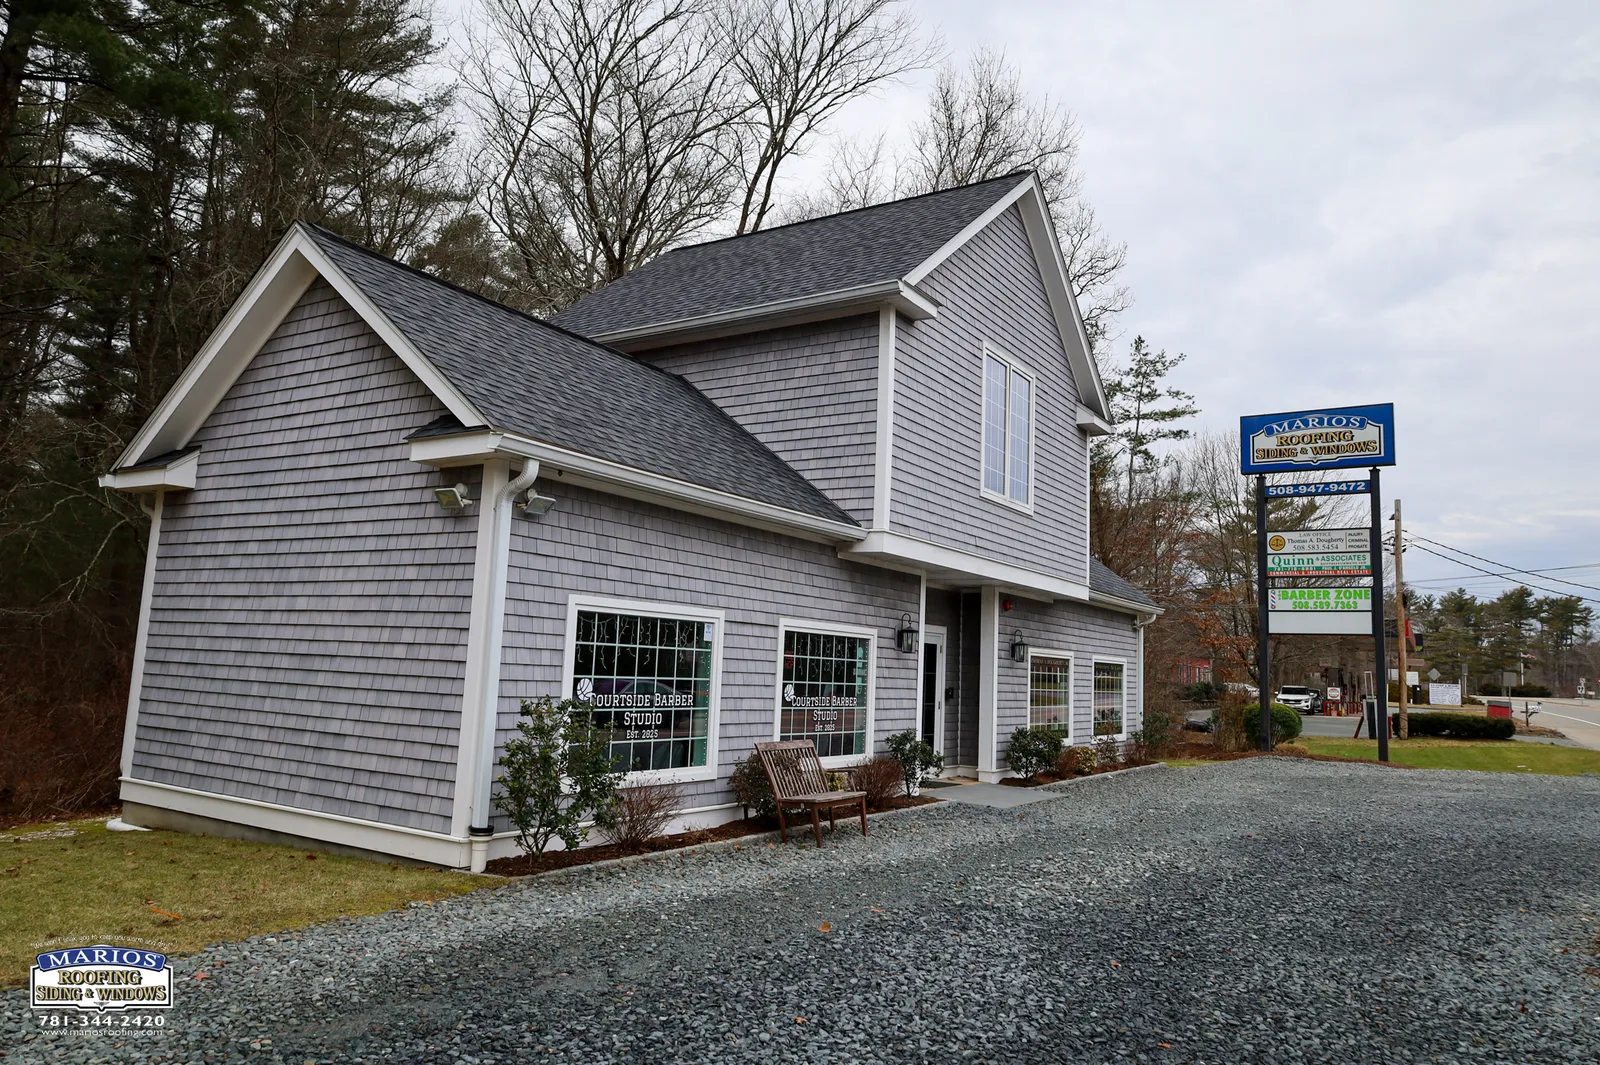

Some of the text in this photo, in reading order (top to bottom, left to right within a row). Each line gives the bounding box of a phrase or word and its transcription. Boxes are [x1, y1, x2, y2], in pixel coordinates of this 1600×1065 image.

[1272, 416, 1361, 435] MARIOS
[1276, 430, 1355, 446] ROOFING
[1256, 440, 1377, 460] SIDING & WINDOWS
[1269, 482, 1366, 496] 508-947-9472
[1316, 536, 1344, 544] Dougherty
[1293, 543, 1339, 552] 508.583.5454
[1271, 555, 1315, 567] Quinn
[1320, 554, 1367, 562] ASSOCIATES
[1281, 589, 1331, 600] BARBER
[1334, 589, 1371, 600] ZONE
[1292, 600, 1358, 610] 508.589.7363
[654, 693, 694, 707] BARBER
[832, 695, 858, 707] BARBER
[623, 711, 663, 726] STUDIO
[813, 710, 838, 721] STUDIO
